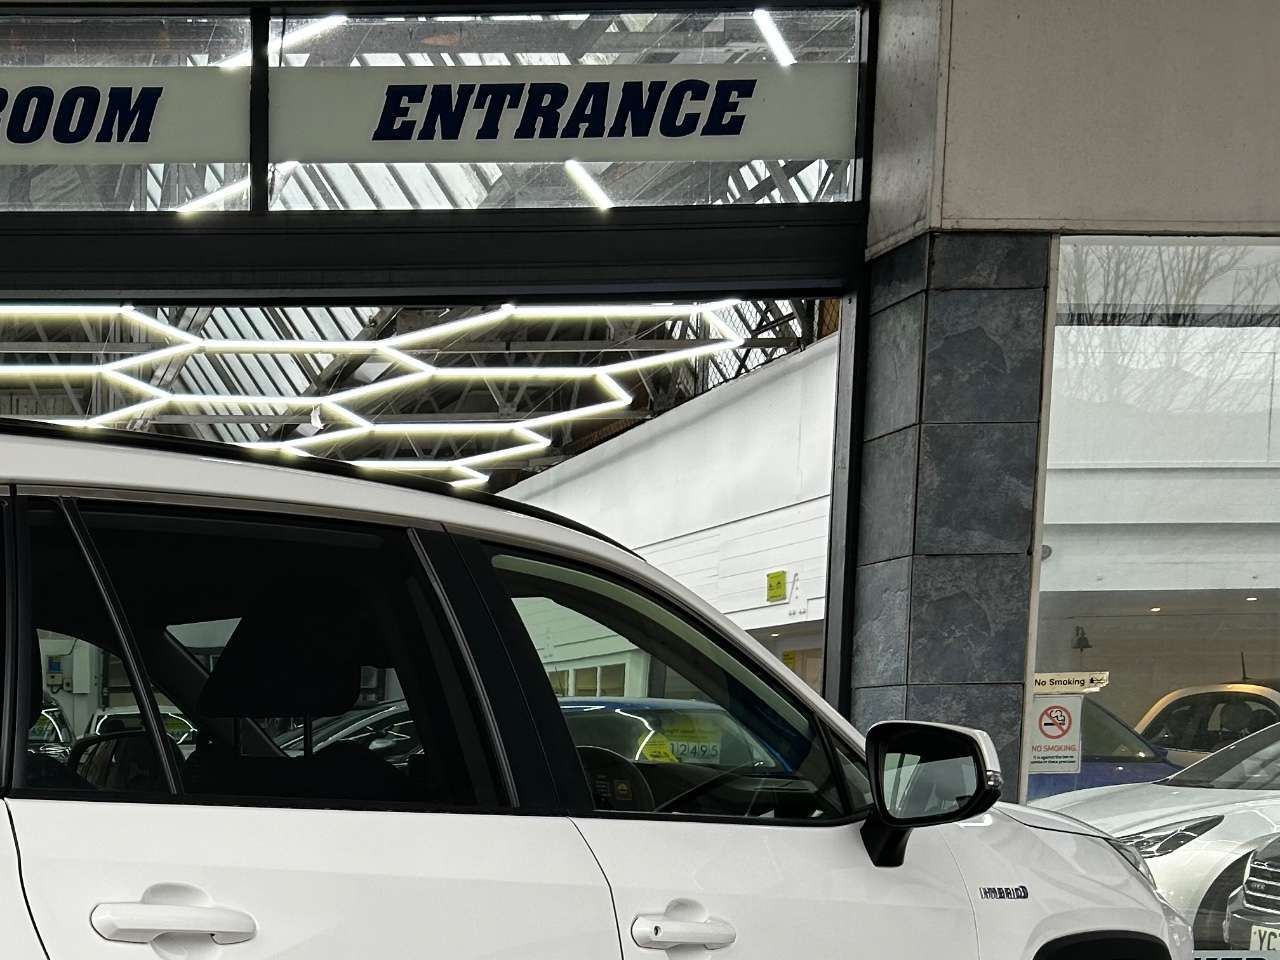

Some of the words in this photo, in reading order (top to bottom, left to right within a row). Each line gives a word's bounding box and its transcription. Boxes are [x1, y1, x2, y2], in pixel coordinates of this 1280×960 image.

[371, 79, 757, 141] ENTRANCE
[1034, 678, 1047, 687] No
[1049, 677, 1085, 688] Smoking
[1031, 744, 1042, 753] NO
[1042, 743, 1077, 753] SMOKING
[1258, 928, 1280, 950] YC
